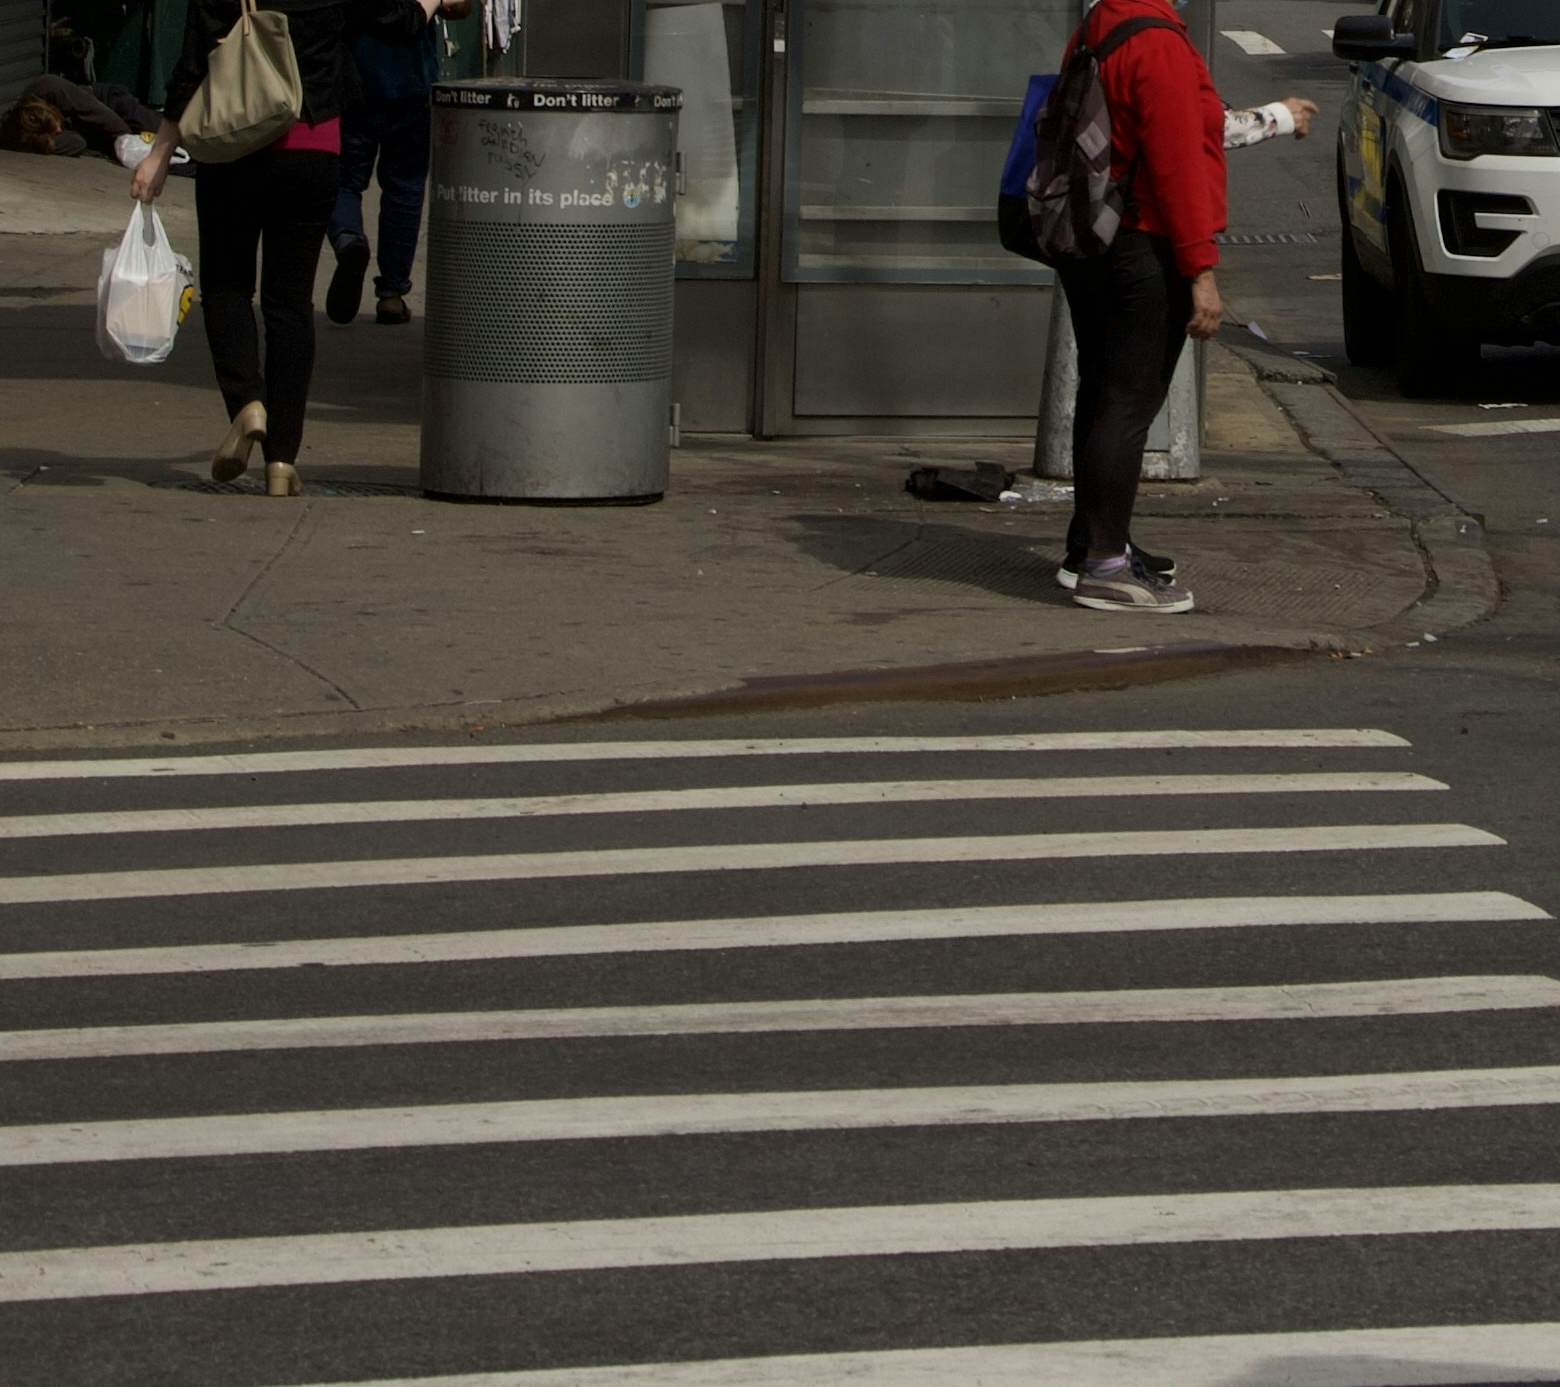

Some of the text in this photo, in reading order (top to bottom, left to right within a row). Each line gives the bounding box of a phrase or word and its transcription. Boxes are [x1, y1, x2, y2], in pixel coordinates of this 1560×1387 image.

[461, 89, 493, 105] litter
[533, 92, 621, 108] Don't litter
[503, 187, 523, 205] in
[529, 188, 555, 207] its
[559, 189, 614, 210] place
